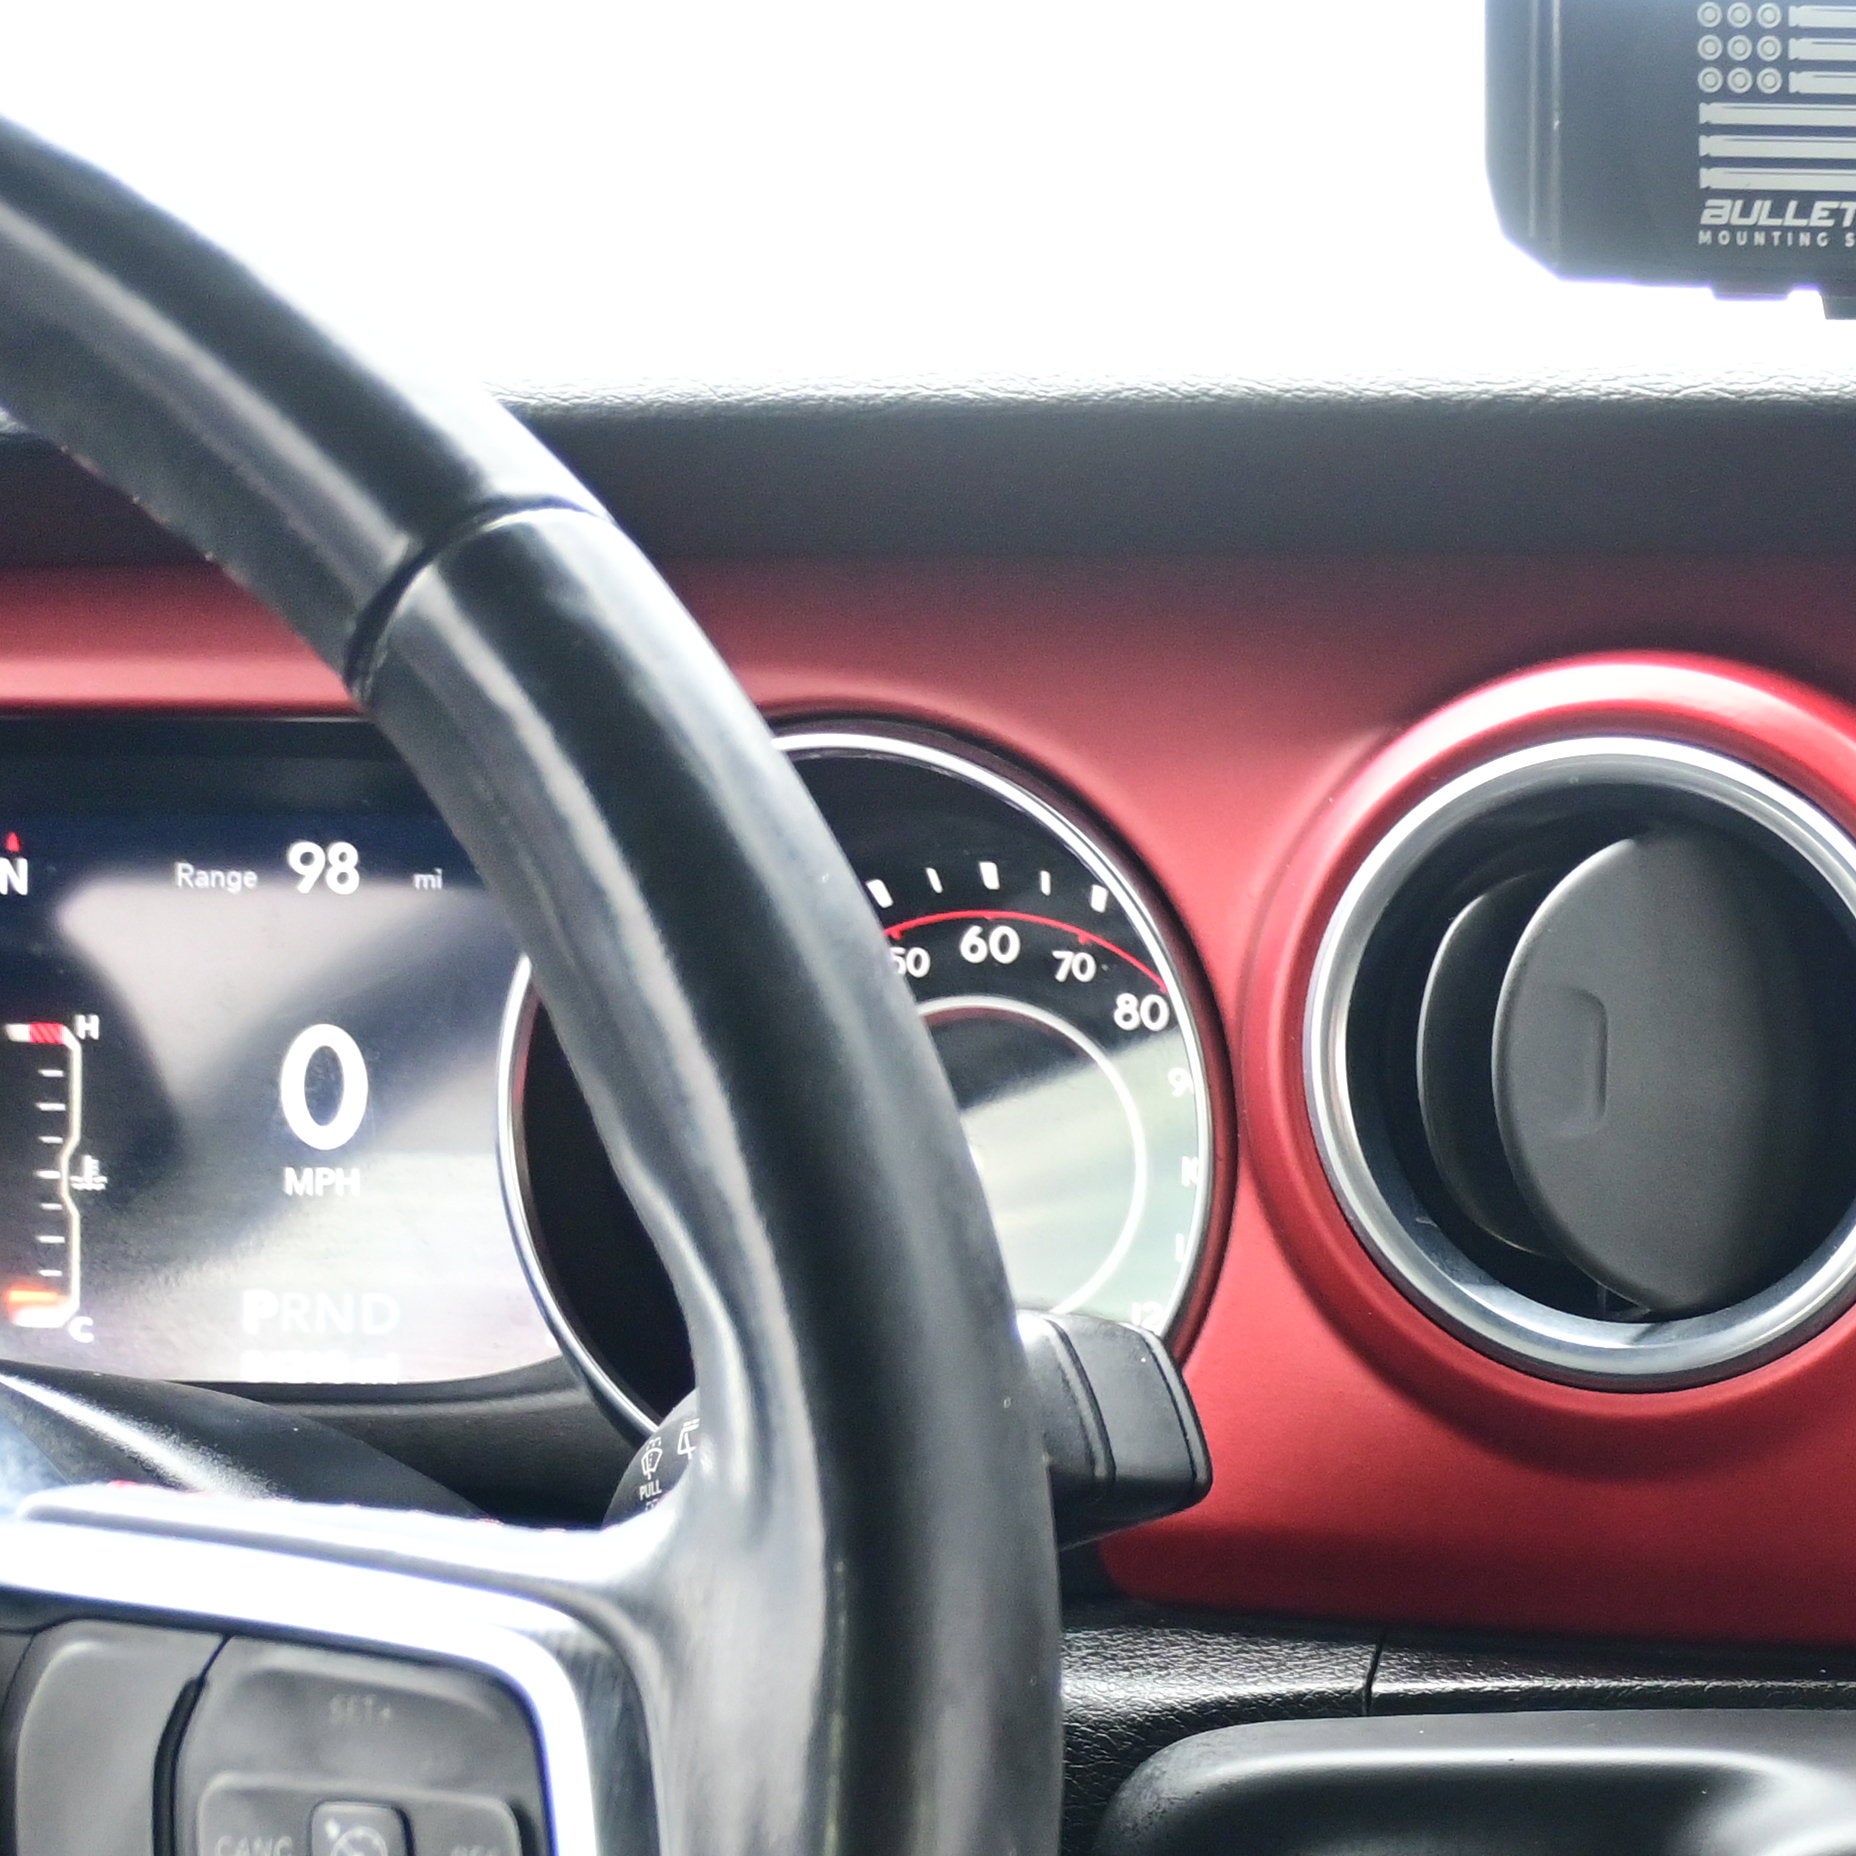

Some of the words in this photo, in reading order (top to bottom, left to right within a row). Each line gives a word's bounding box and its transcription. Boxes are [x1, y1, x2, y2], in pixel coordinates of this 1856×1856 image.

[1698, 230, 1830, 248] MOUNTING
[0, 857, 29, 896] N
[175, 861, 259, 894] Range
[287, 841, 360, 895] 98
[413, 868, 444, 890] mi
[959, 925, 1021, 964] 60
[1051, 950, 1096, 982] 70
[75, 1014, 99, 1040] H
[1113, 992, 1170, 1031] 80
[280, 1023, 369, 1151] 0
[283, 1167, 361, 1197] MPH
[639, 1479, 663, 1501] PULL
